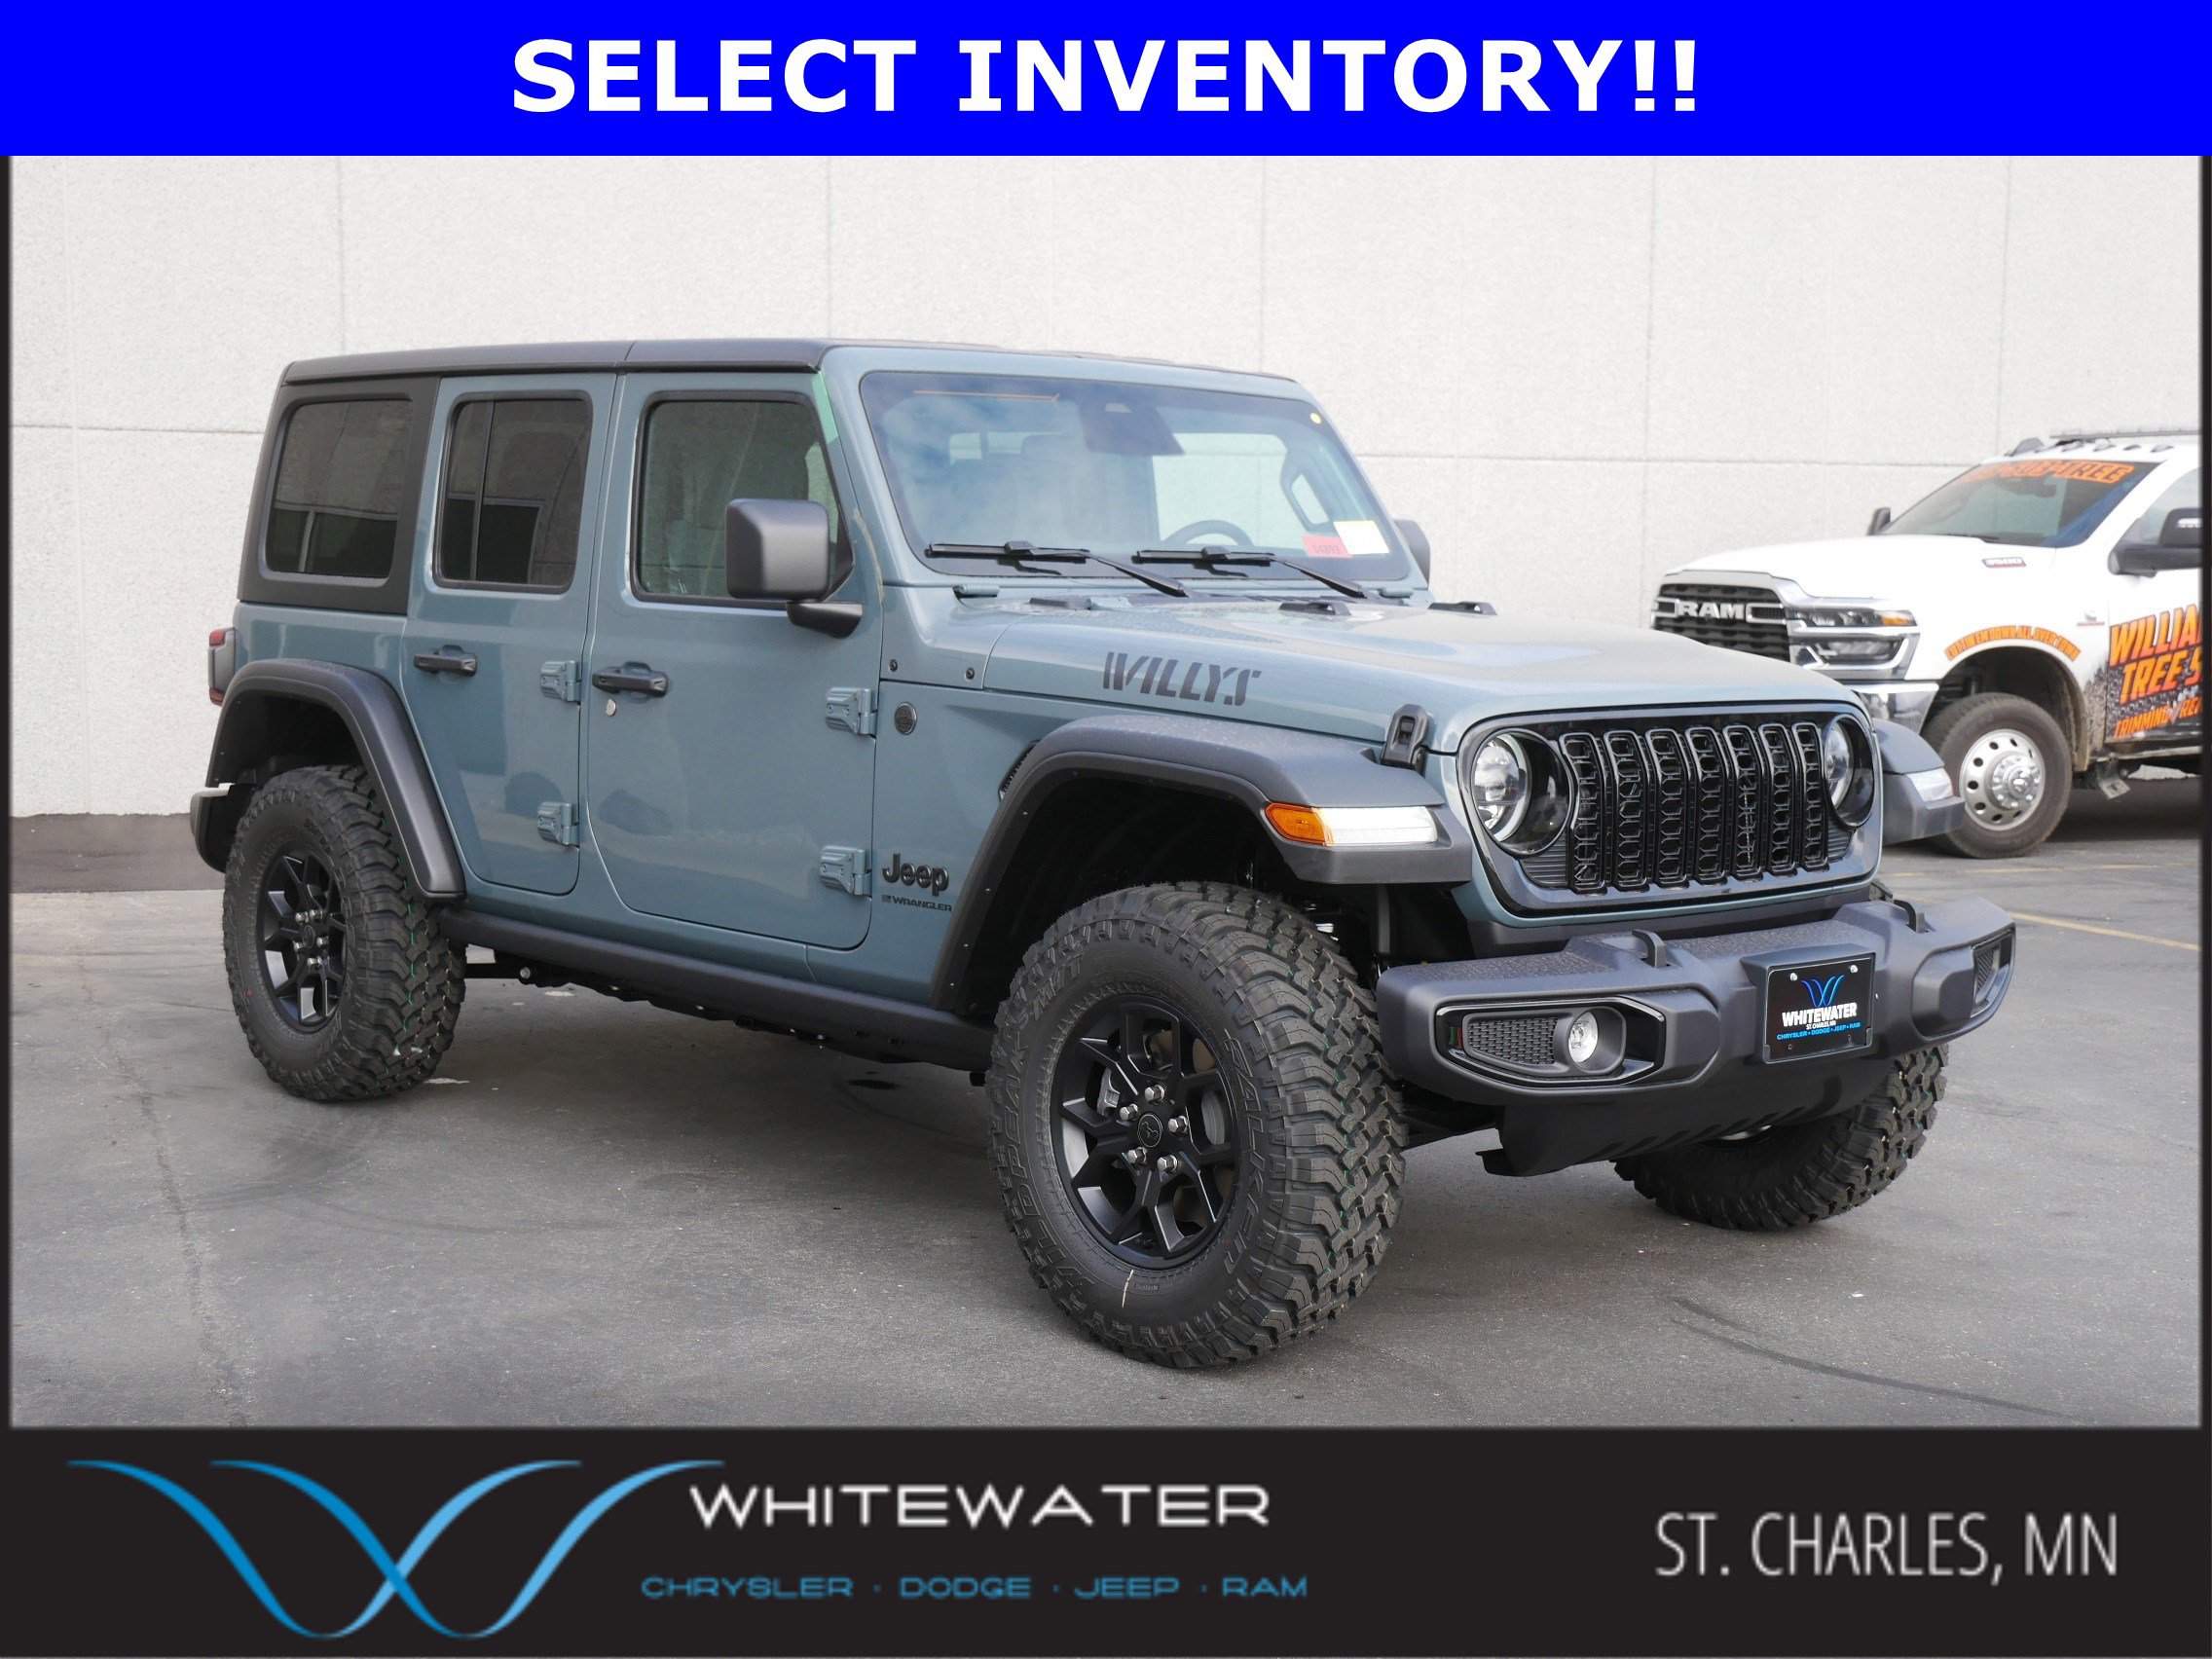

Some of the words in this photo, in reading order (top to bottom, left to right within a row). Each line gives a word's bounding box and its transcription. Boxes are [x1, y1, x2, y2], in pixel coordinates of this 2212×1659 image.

[1677, 601, 1745, 619] RAM
[2110, 604, 2202, 666] WILLIA
[1102, 651, 1262, 706] WILLYS
[2120, 649, 2189, 704] TREE
[882, 853, 949, 896] Jeep
[892, 895, 952, 912] WRANGLER
[1777, 1030, 1808, 1041] CHRYSLER
[1811, 1026, 1830, 1036] DODGE
[1782, 1002, 1858, 1027] WHITEWATER
[1218, 1028, 1265, 1275] FALKEN
